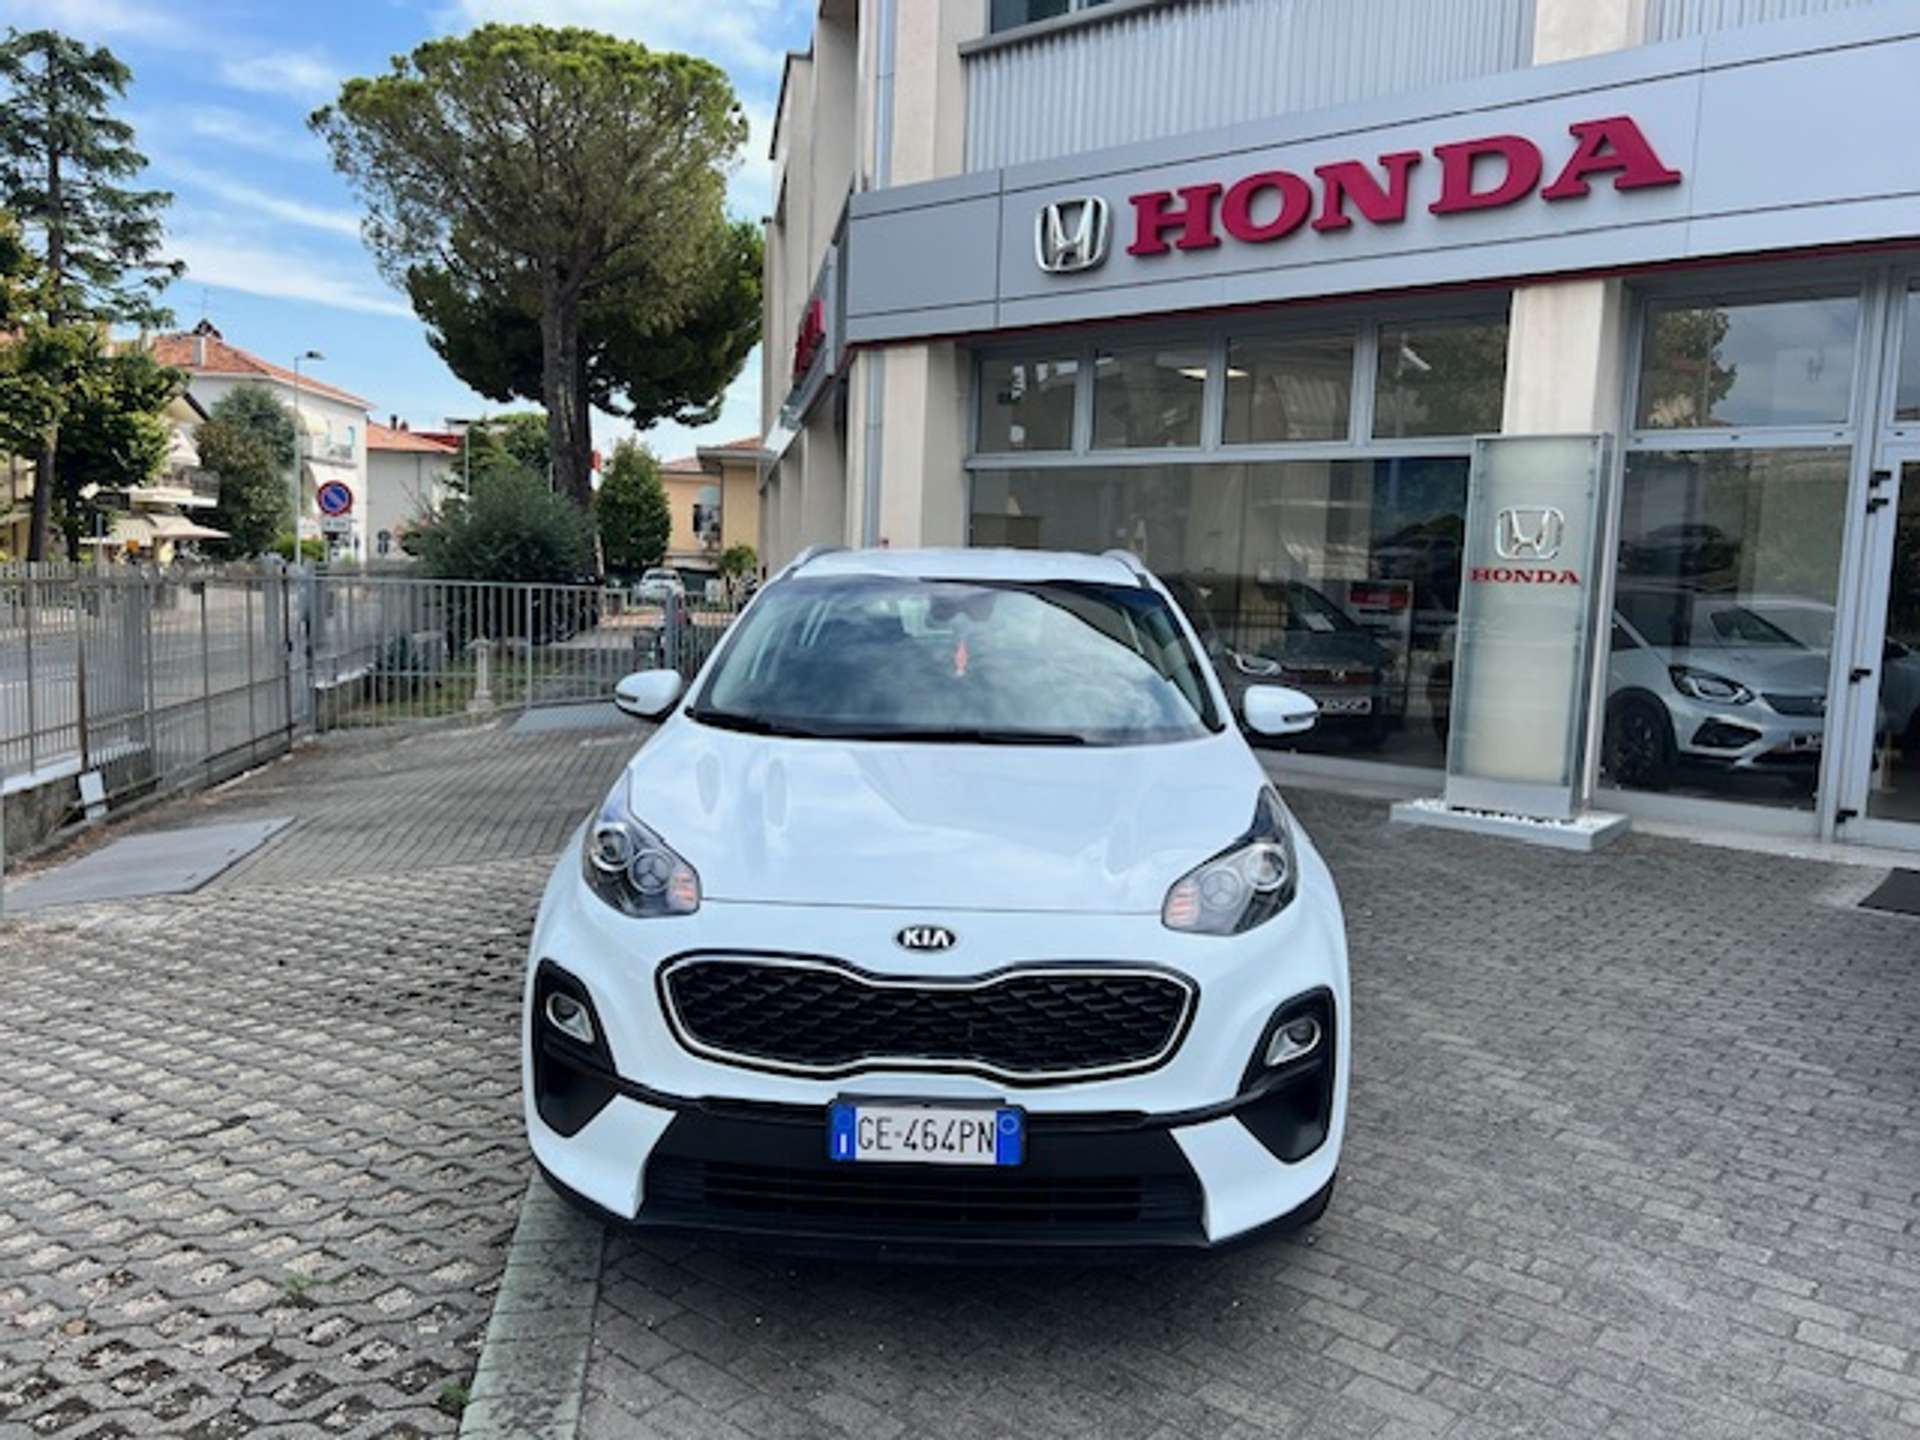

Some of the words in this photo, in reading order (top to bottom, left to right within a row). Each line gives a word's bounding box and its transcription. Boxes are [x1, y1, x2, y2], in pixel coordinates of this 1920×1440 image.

[1127, 115, 1681, 256] HONDA
[1470, 567, 1580, 585] HONDA
[904, 929, 949, 947] KIA
